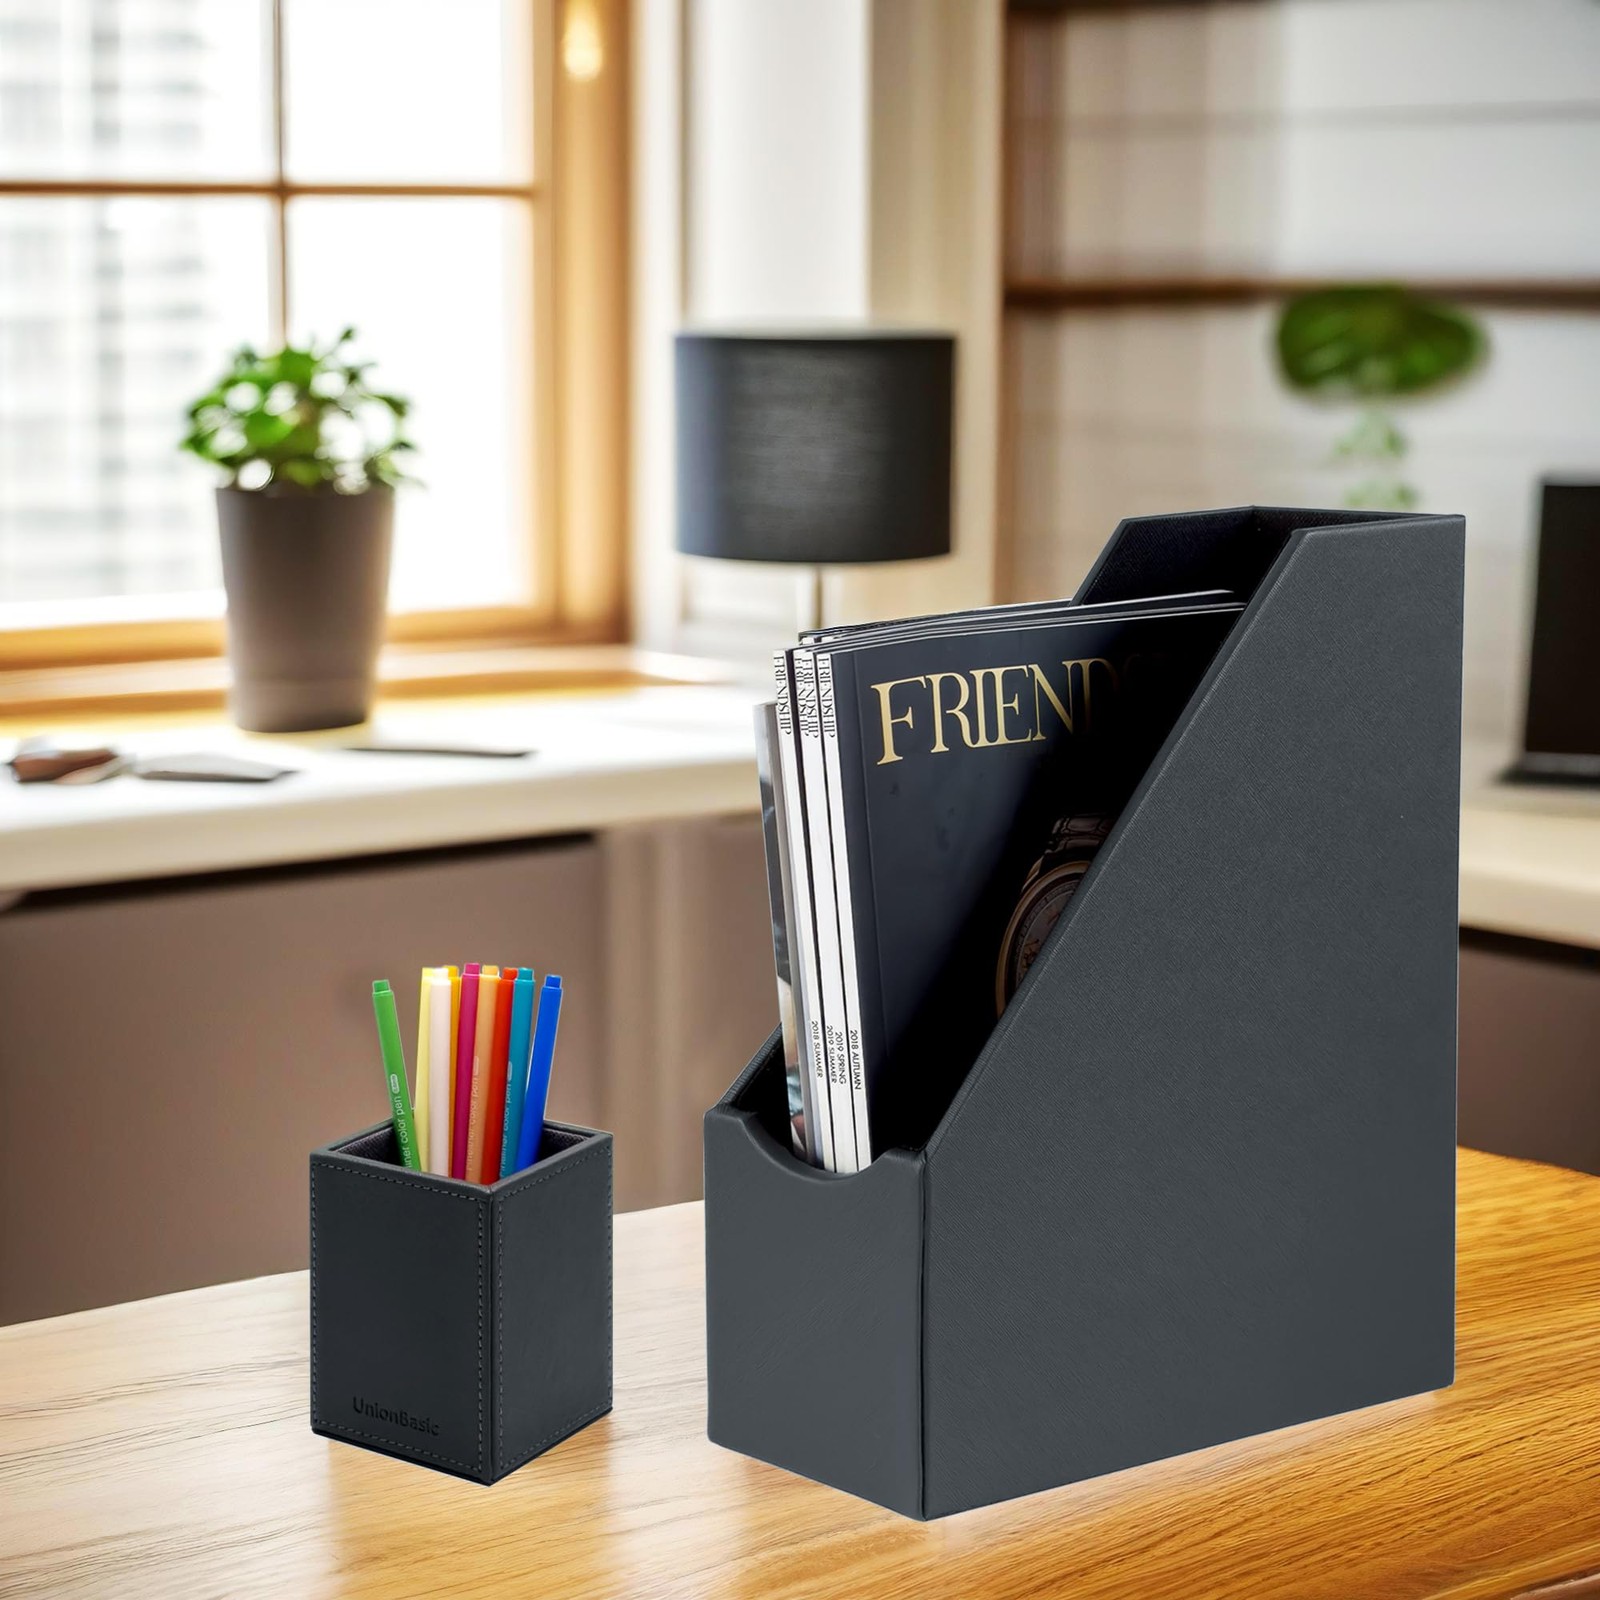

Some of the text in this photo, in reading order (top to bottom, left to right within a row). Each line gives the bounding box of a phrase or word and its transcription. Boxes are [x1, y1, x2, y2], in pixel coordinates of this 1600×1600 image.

[773, 656, 792, 735] FRIENDSHIP
[802, 659, 819, 738] FRIENDSHIP
[818, 658, 836, 738] FRIENDSHIP
[870, 653, 1142, 766] FRIEND
[811, 1020, 823, 1078] 2018 SUMMER
[826, 1025, 838, 1083] 2019 SUMMER
[835, 1031, 847, 1085] 2019 SPRING
[850, 1029, 862, 1090] 2018 AUTUMN
[394, 1095, 403, 1116] pen
[398, 1118, 409, 1143] color
[352, 1396, 440, 1437] UnionBasic
